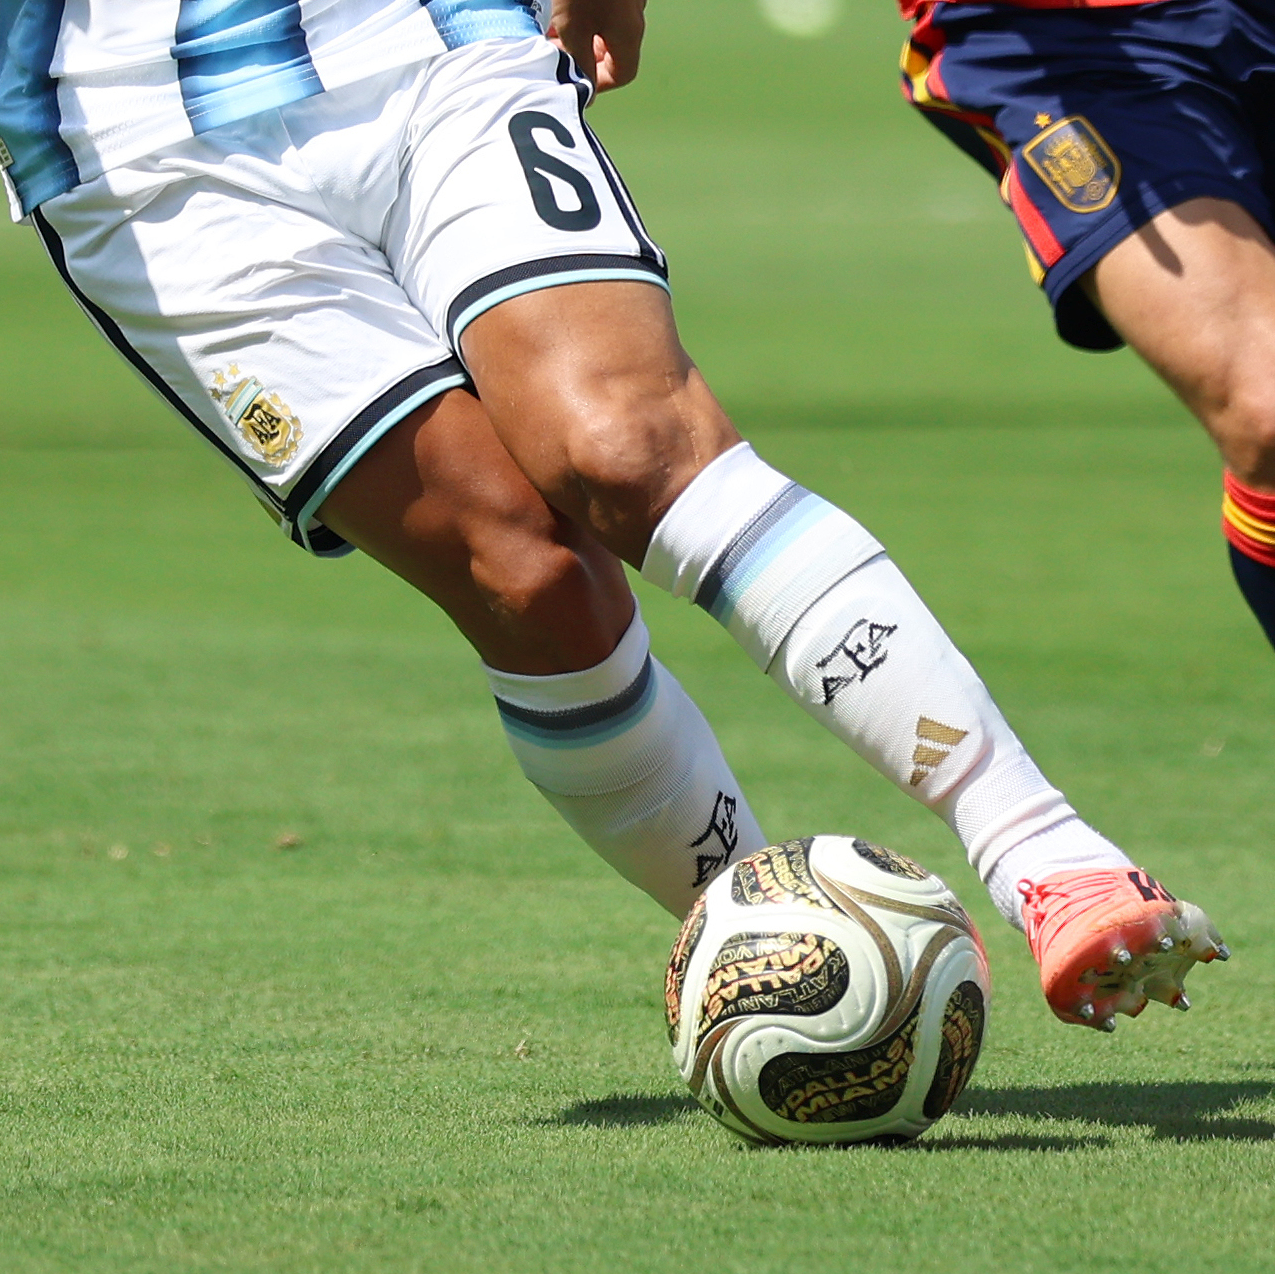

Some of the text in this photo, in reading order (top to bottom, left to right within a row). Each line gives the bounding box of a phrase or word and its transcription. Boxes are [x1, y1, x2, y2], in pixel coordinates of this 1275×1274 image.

[508, 111, 601, 232] 6
[244, 404, 281, 446] AFA
[815, 618, 898, 706] AFA
[691, 790, 738, 887] AFA
[701, 934, 818, 1006] MIAMI
[707, 948, 825, 1020] DALLAS
[786, 1037, 905, 1110] DALLAS
